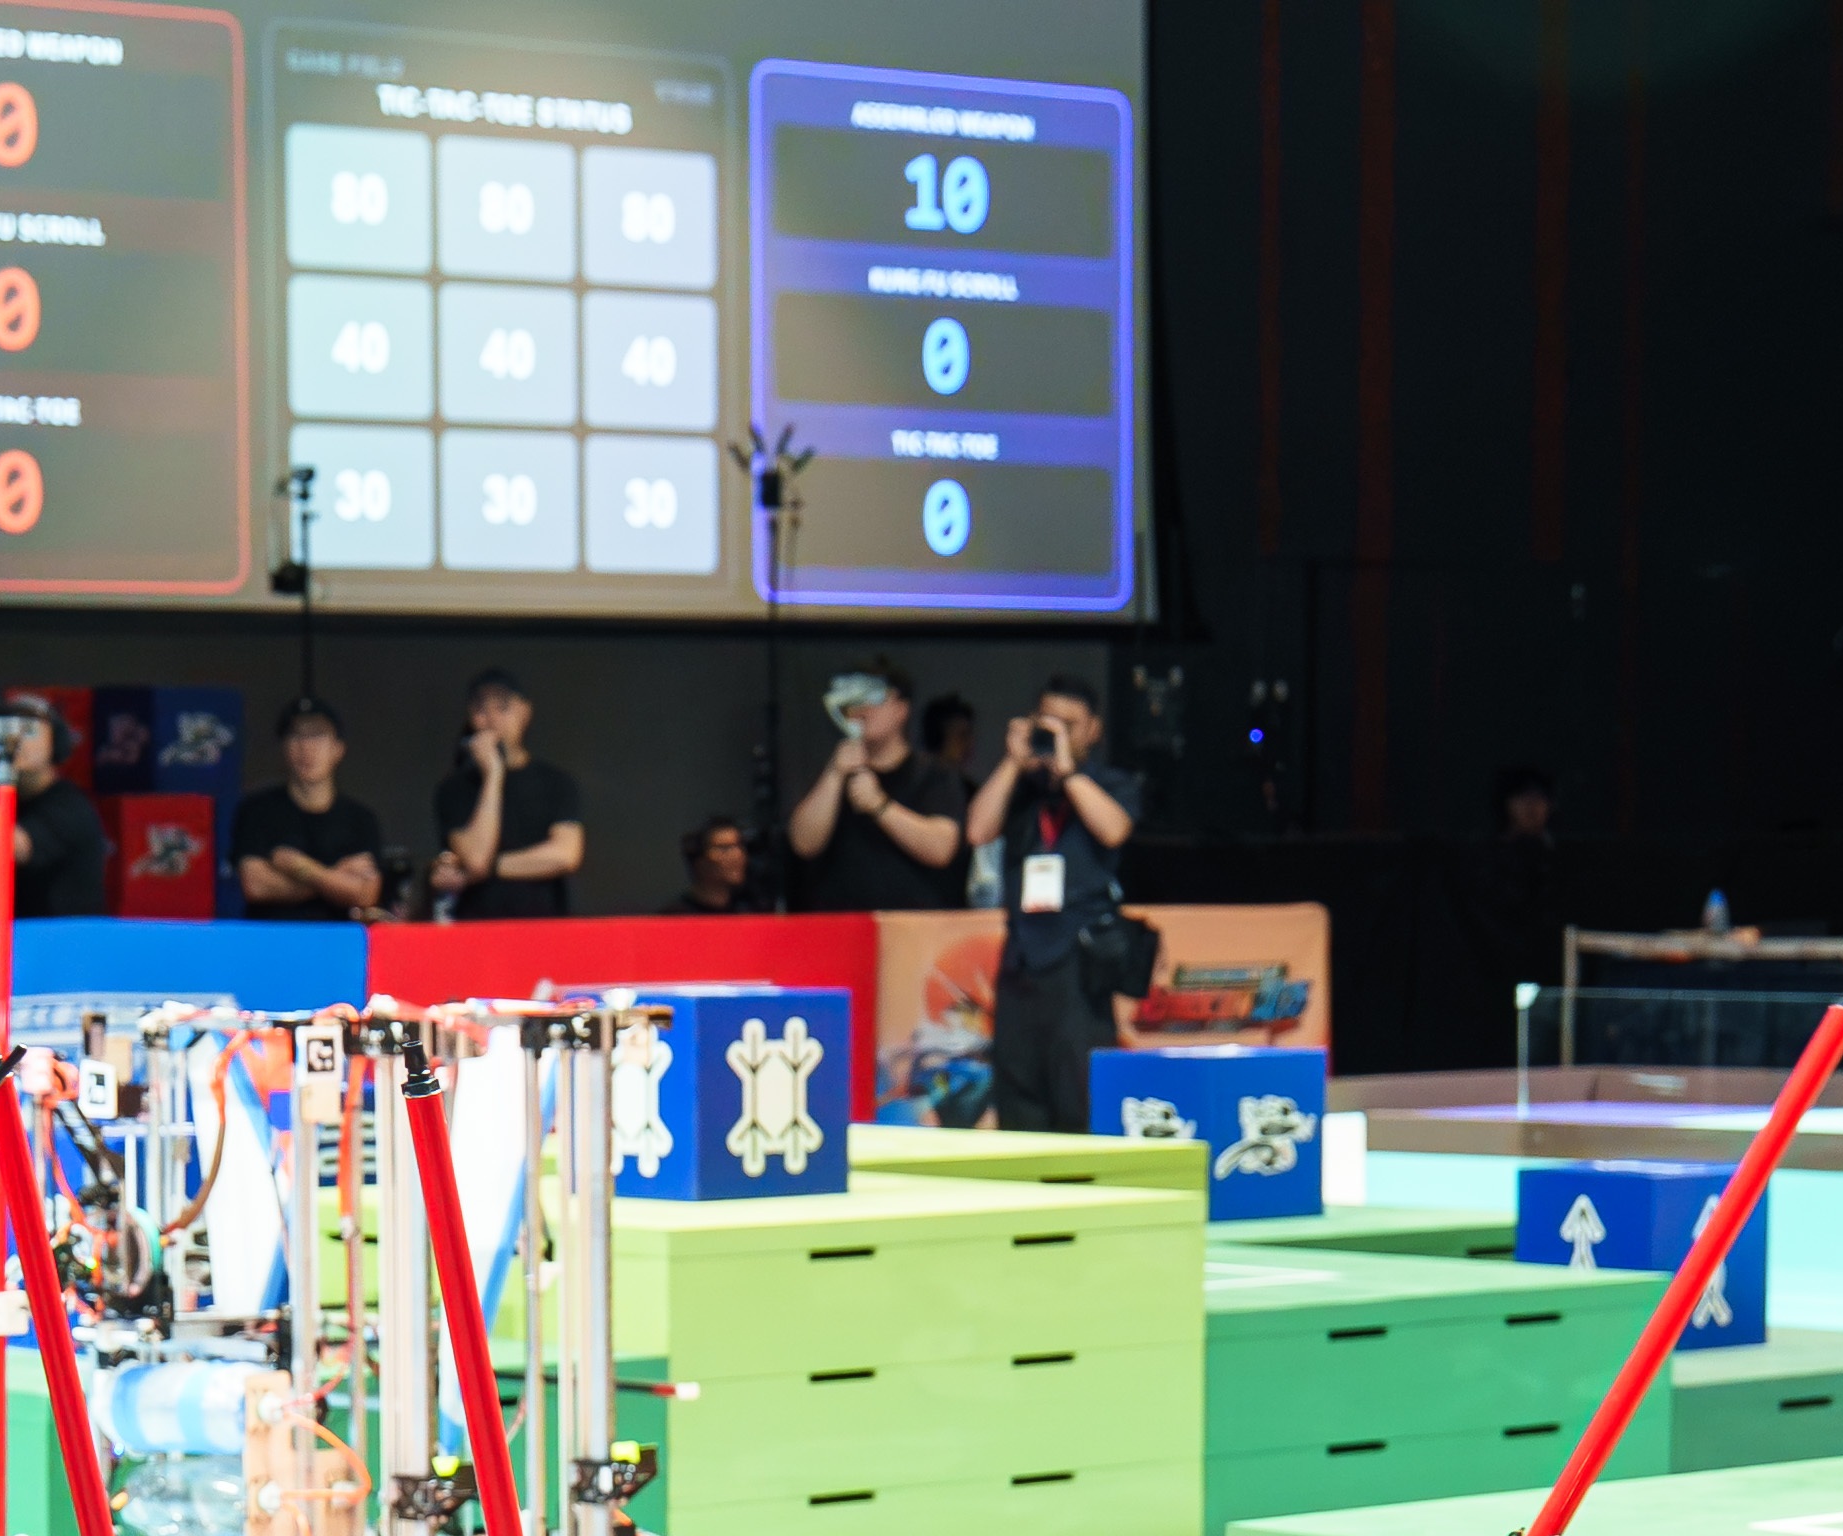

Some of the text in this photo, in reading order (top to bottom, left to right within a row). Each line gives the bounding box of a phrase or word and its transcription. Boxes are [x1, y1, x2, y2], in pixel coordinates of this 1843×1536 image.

[25, 30, 124, 66] WEAPON
[536, 96, 633, 135] STATUS
[851, 101, 1036, 142] ASSEMBLED WEAPON
[330, 171, 676, 245] 80 80 80
[904, 153, 990, 234] 10
[17, 212, 106, 246] SCROLL
[867, 265, 1020, 302] KUNG FU SCROLL
[331, 320, 677, 387] 40 40 40
[922, 316, 970, 396] 0
[334, 468, 678, 529] 30 30 30
[923, 477, 971, 557] 0
